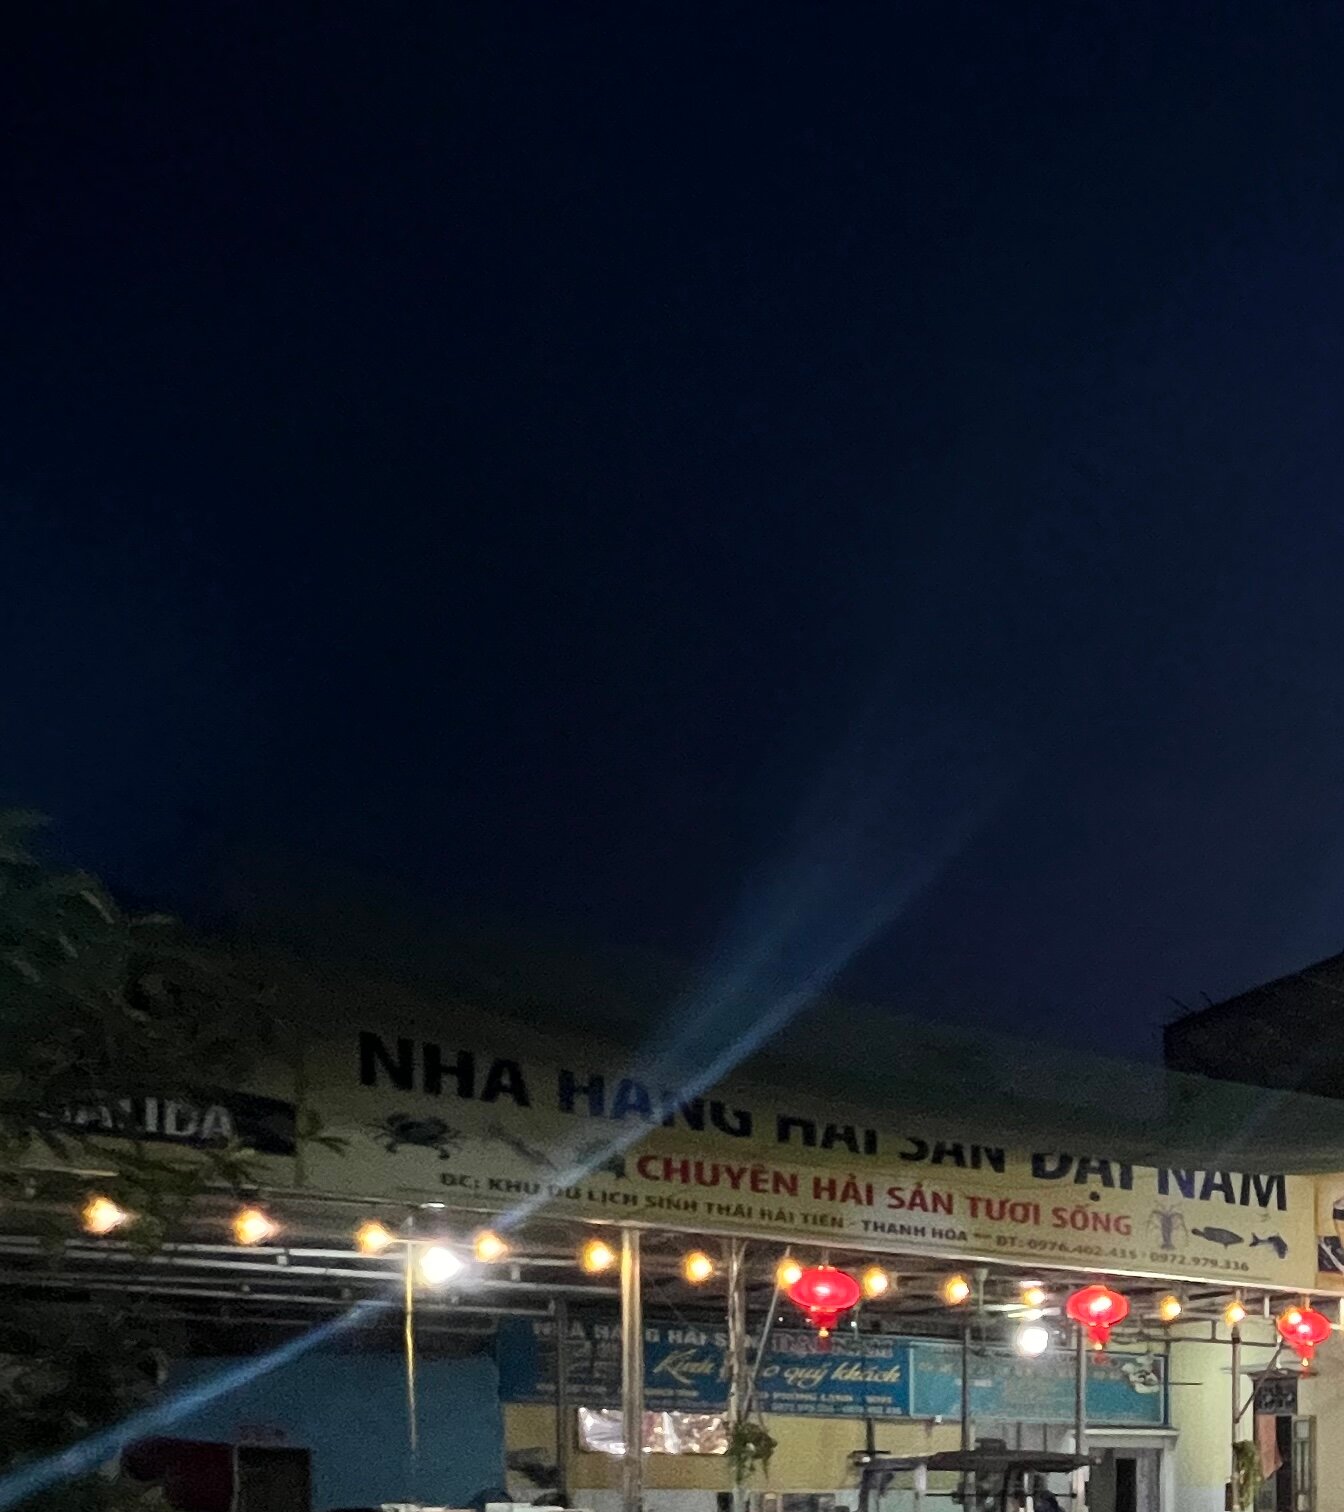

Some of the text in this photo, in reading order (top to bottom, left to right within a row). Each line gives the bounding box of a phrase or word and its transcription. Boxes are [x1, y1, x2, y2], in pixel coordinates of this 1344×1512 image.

[636, 1154, 1133, 1237] CHUYÊN HẢI SẢN TƯƠI SỐNG
[1157, 1167, 1287, 1212] NAM
[861, 1219, 926, 1238] THANH
